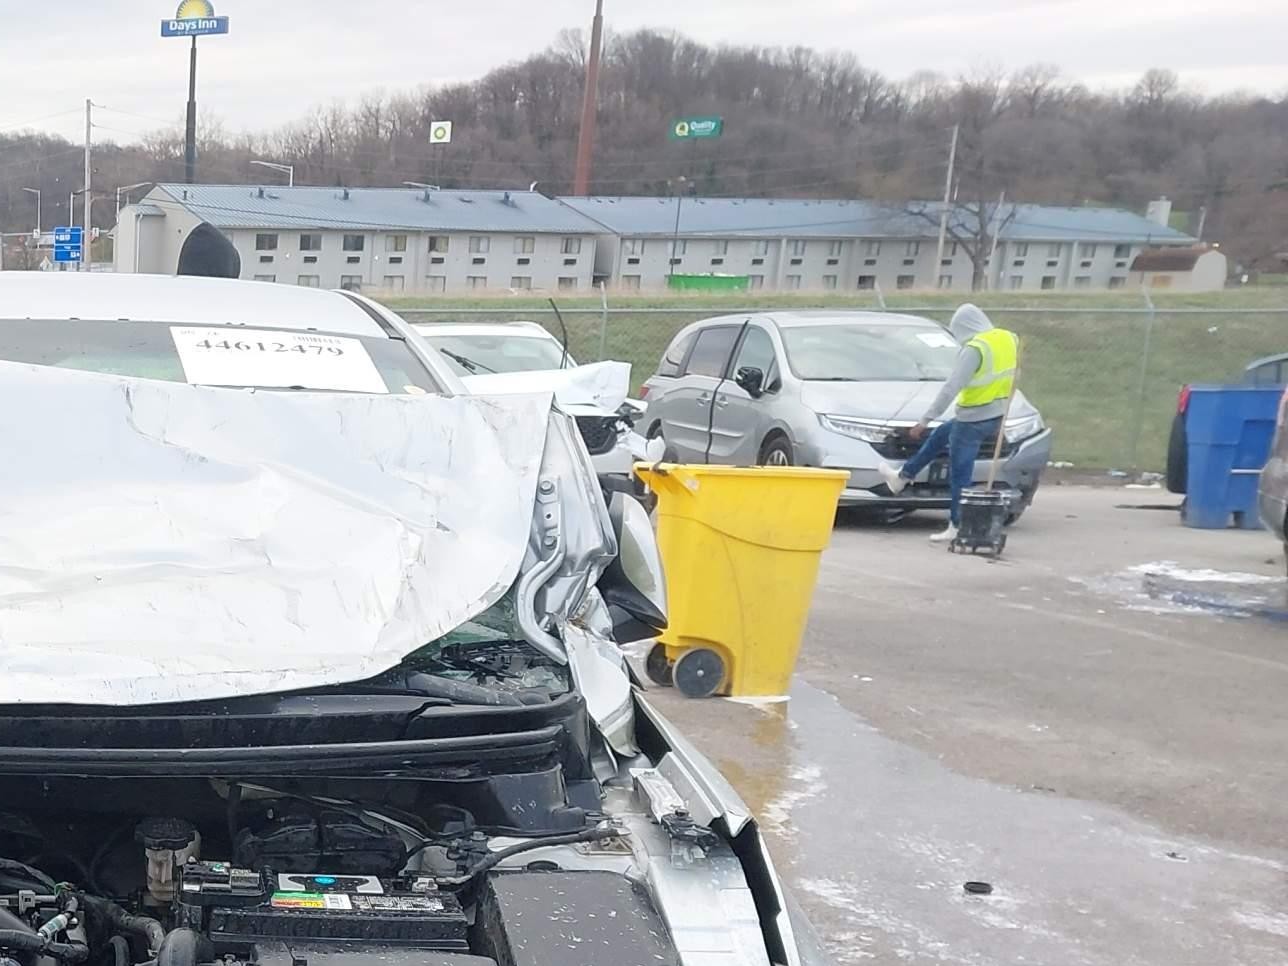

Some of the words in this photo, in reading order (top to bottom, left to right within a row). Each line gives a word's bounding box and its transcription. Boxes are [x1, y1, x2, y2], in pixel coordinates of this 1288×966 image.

[169, 20, 197, 31] Days
[198, 19, 218, 29] Inn
[196, 338, 345, 356] 44612479
